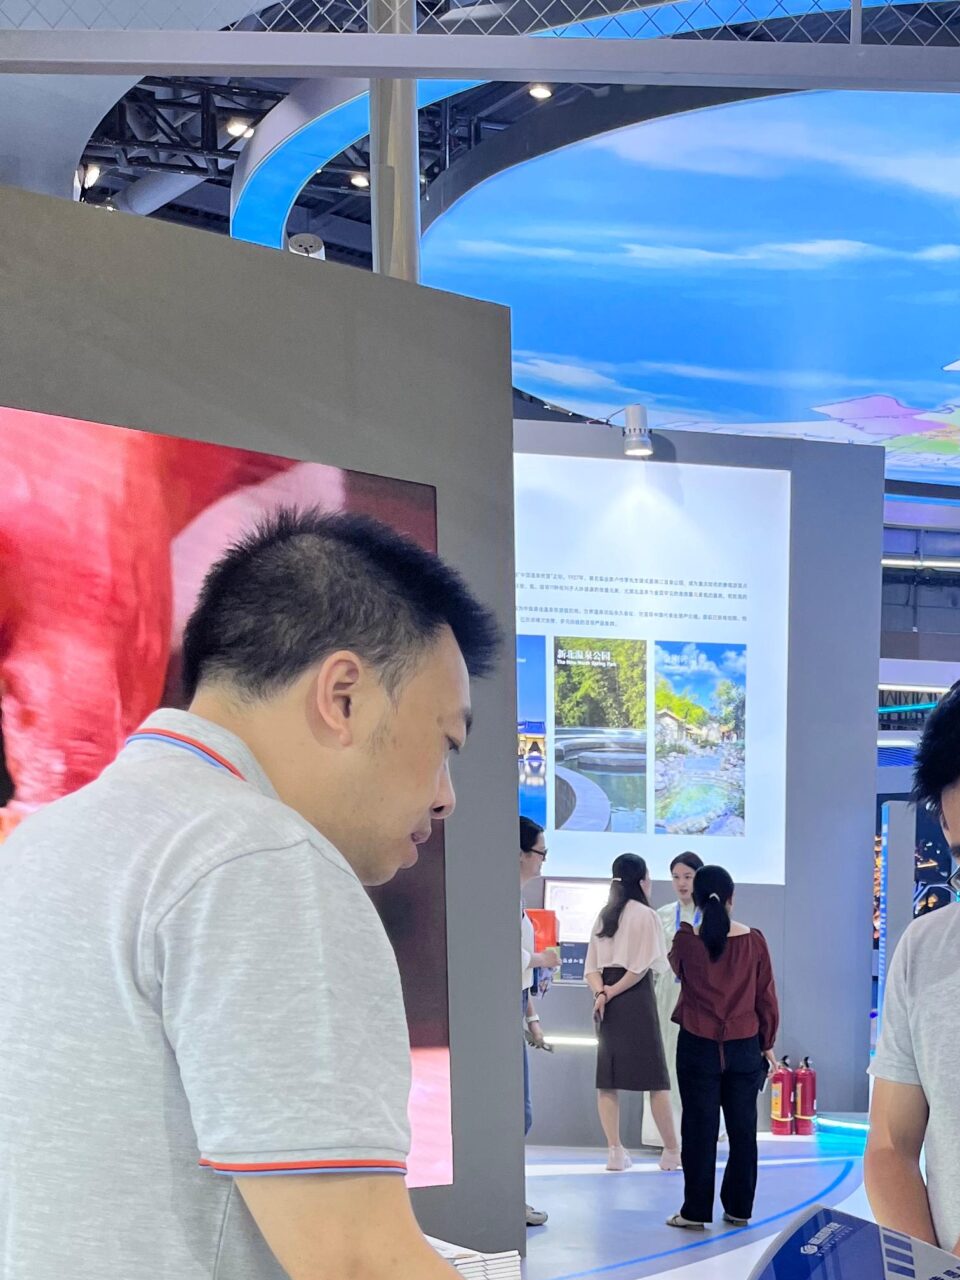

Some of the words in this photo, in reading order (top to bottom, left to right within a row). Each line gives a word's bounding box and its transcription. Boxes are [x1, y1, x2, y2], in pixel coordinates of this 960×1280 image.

[557, 648, 610, 661] 新北温泉公园
